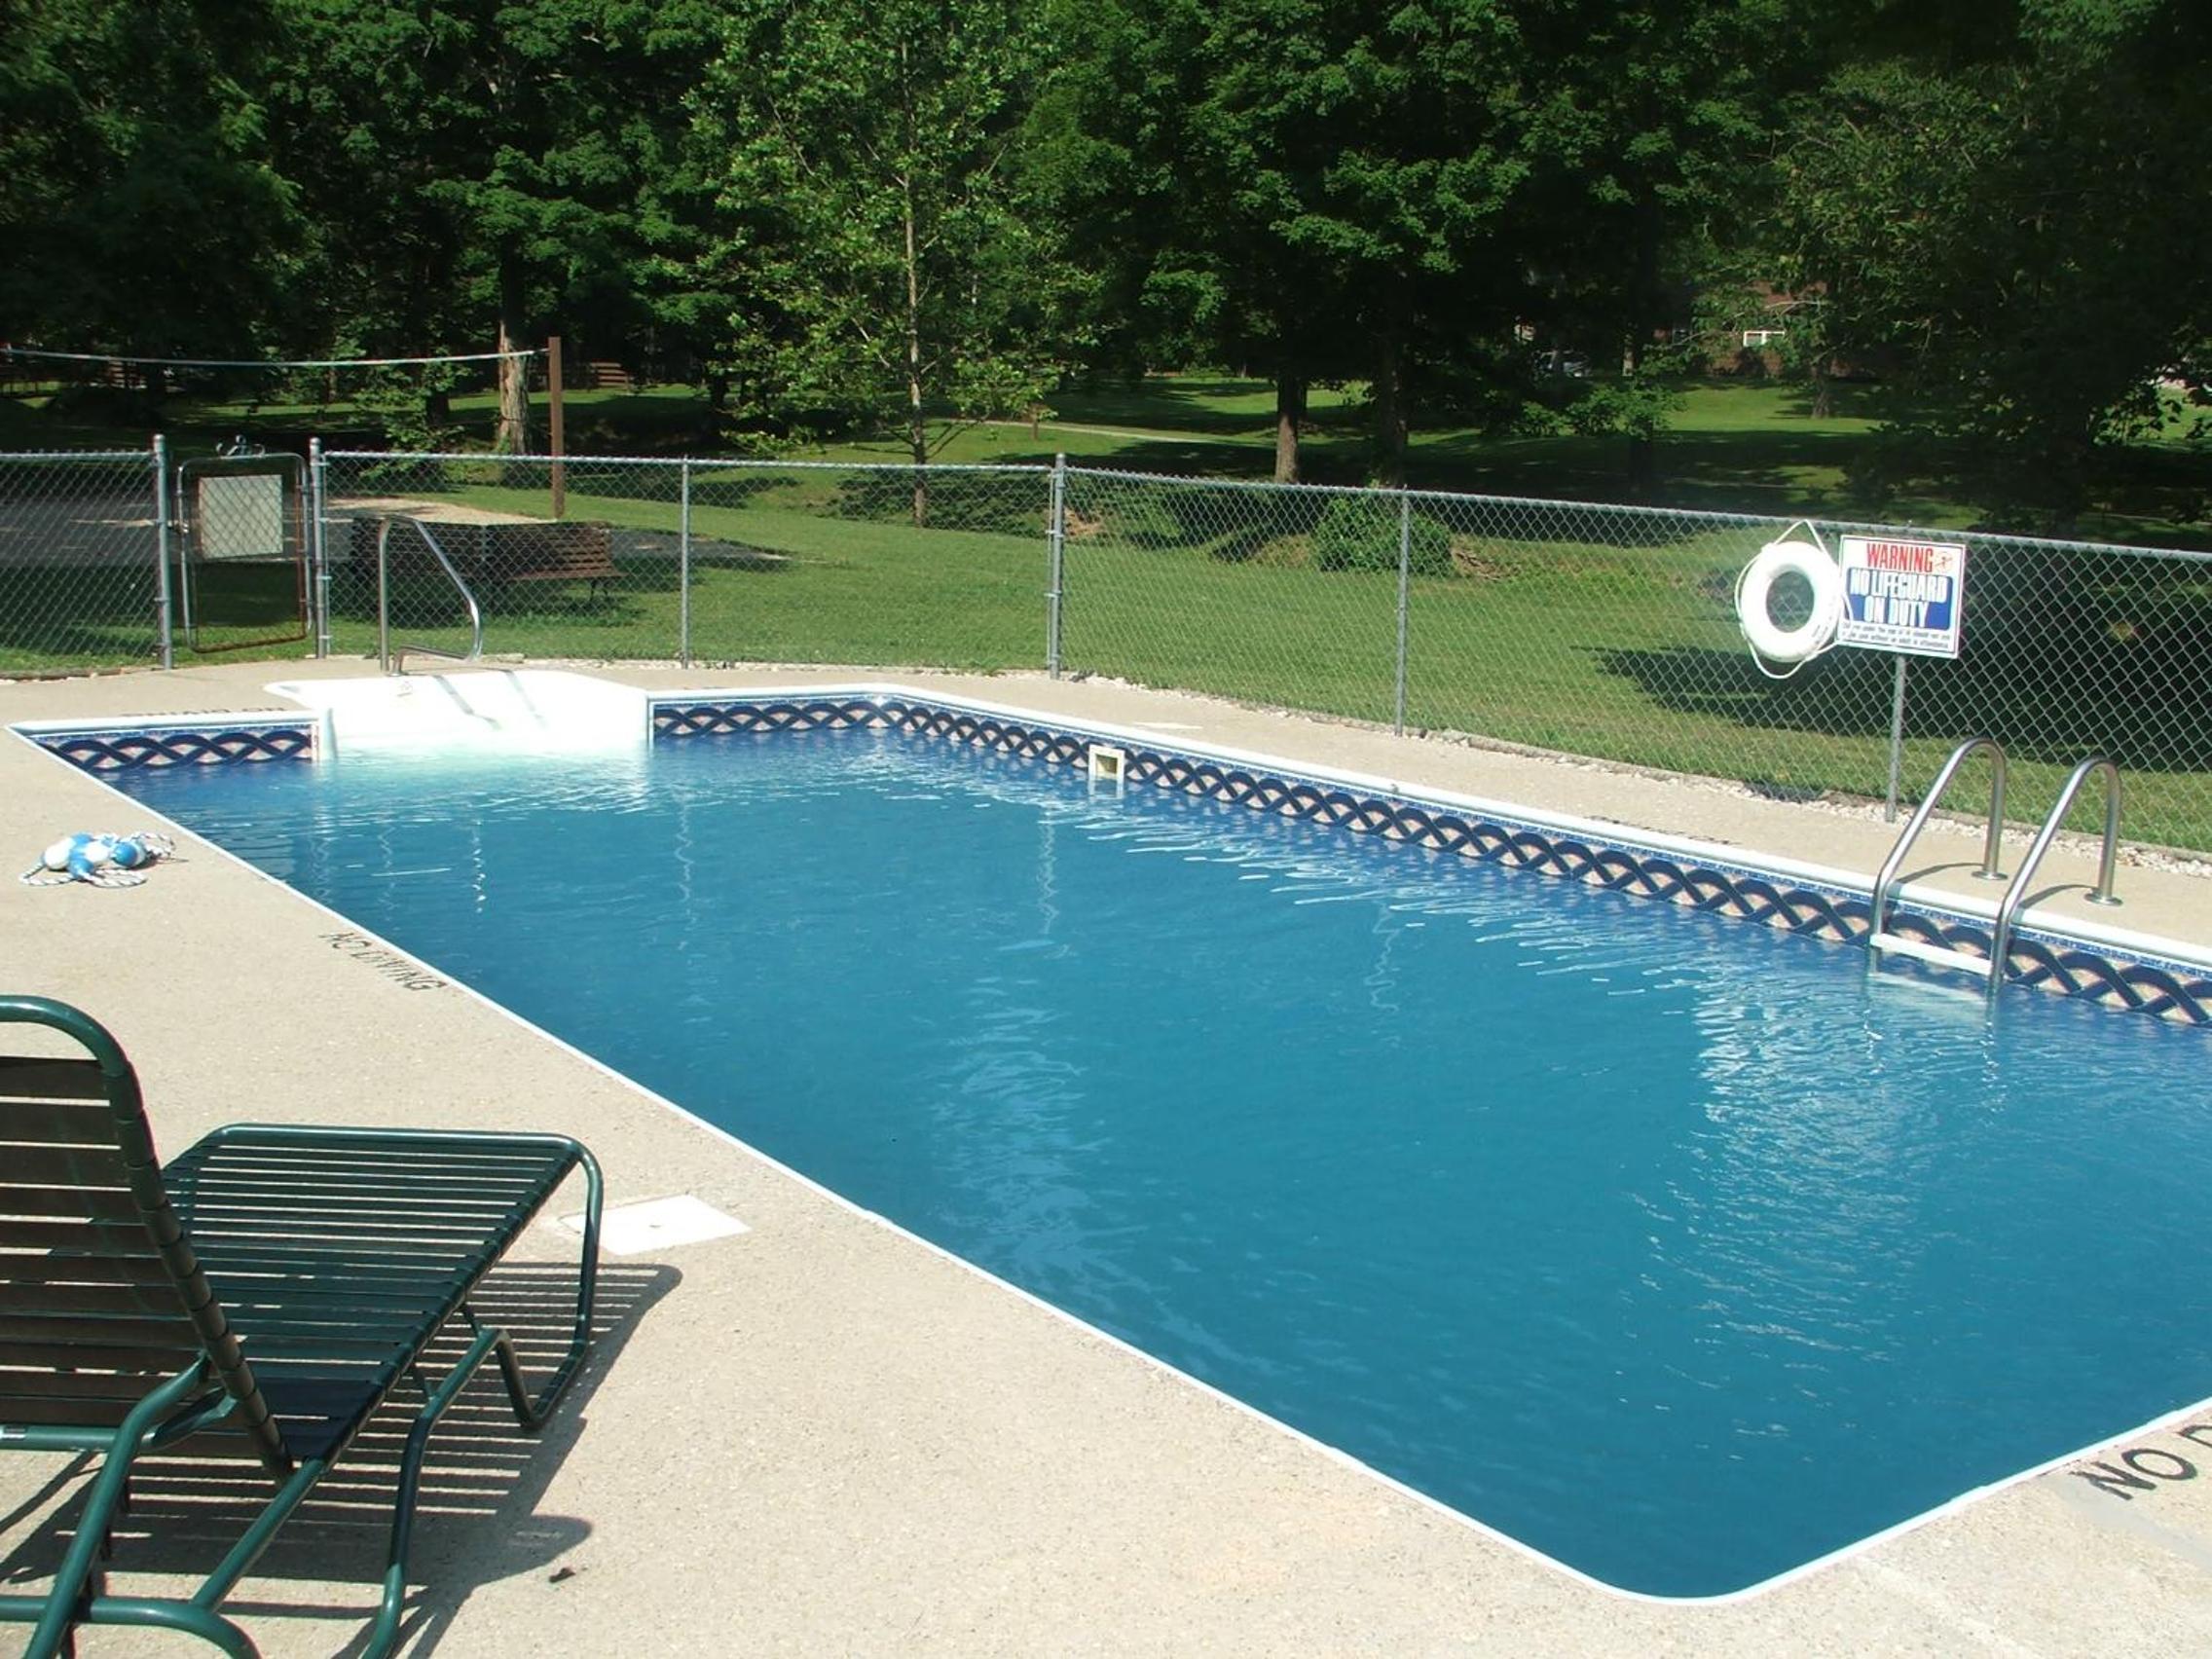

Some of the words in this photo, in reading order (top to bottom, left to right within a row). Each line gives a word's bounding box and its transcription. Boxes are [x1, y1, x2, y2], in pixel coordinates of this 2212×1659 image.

[1866, 543, 1934, 572] WARNING
[1849, 568, 1870, 596] NO
[1871, 570, 1948, 603] LIFEGUARD
[1863, 595, 1885, 623] ON
[1888, 597, 1930, 627] DUTY
[317, 932, 372, 949] NO
[350, 950, 448, 991] DIVING
[2068, 1448, 2198, 1500] NO
